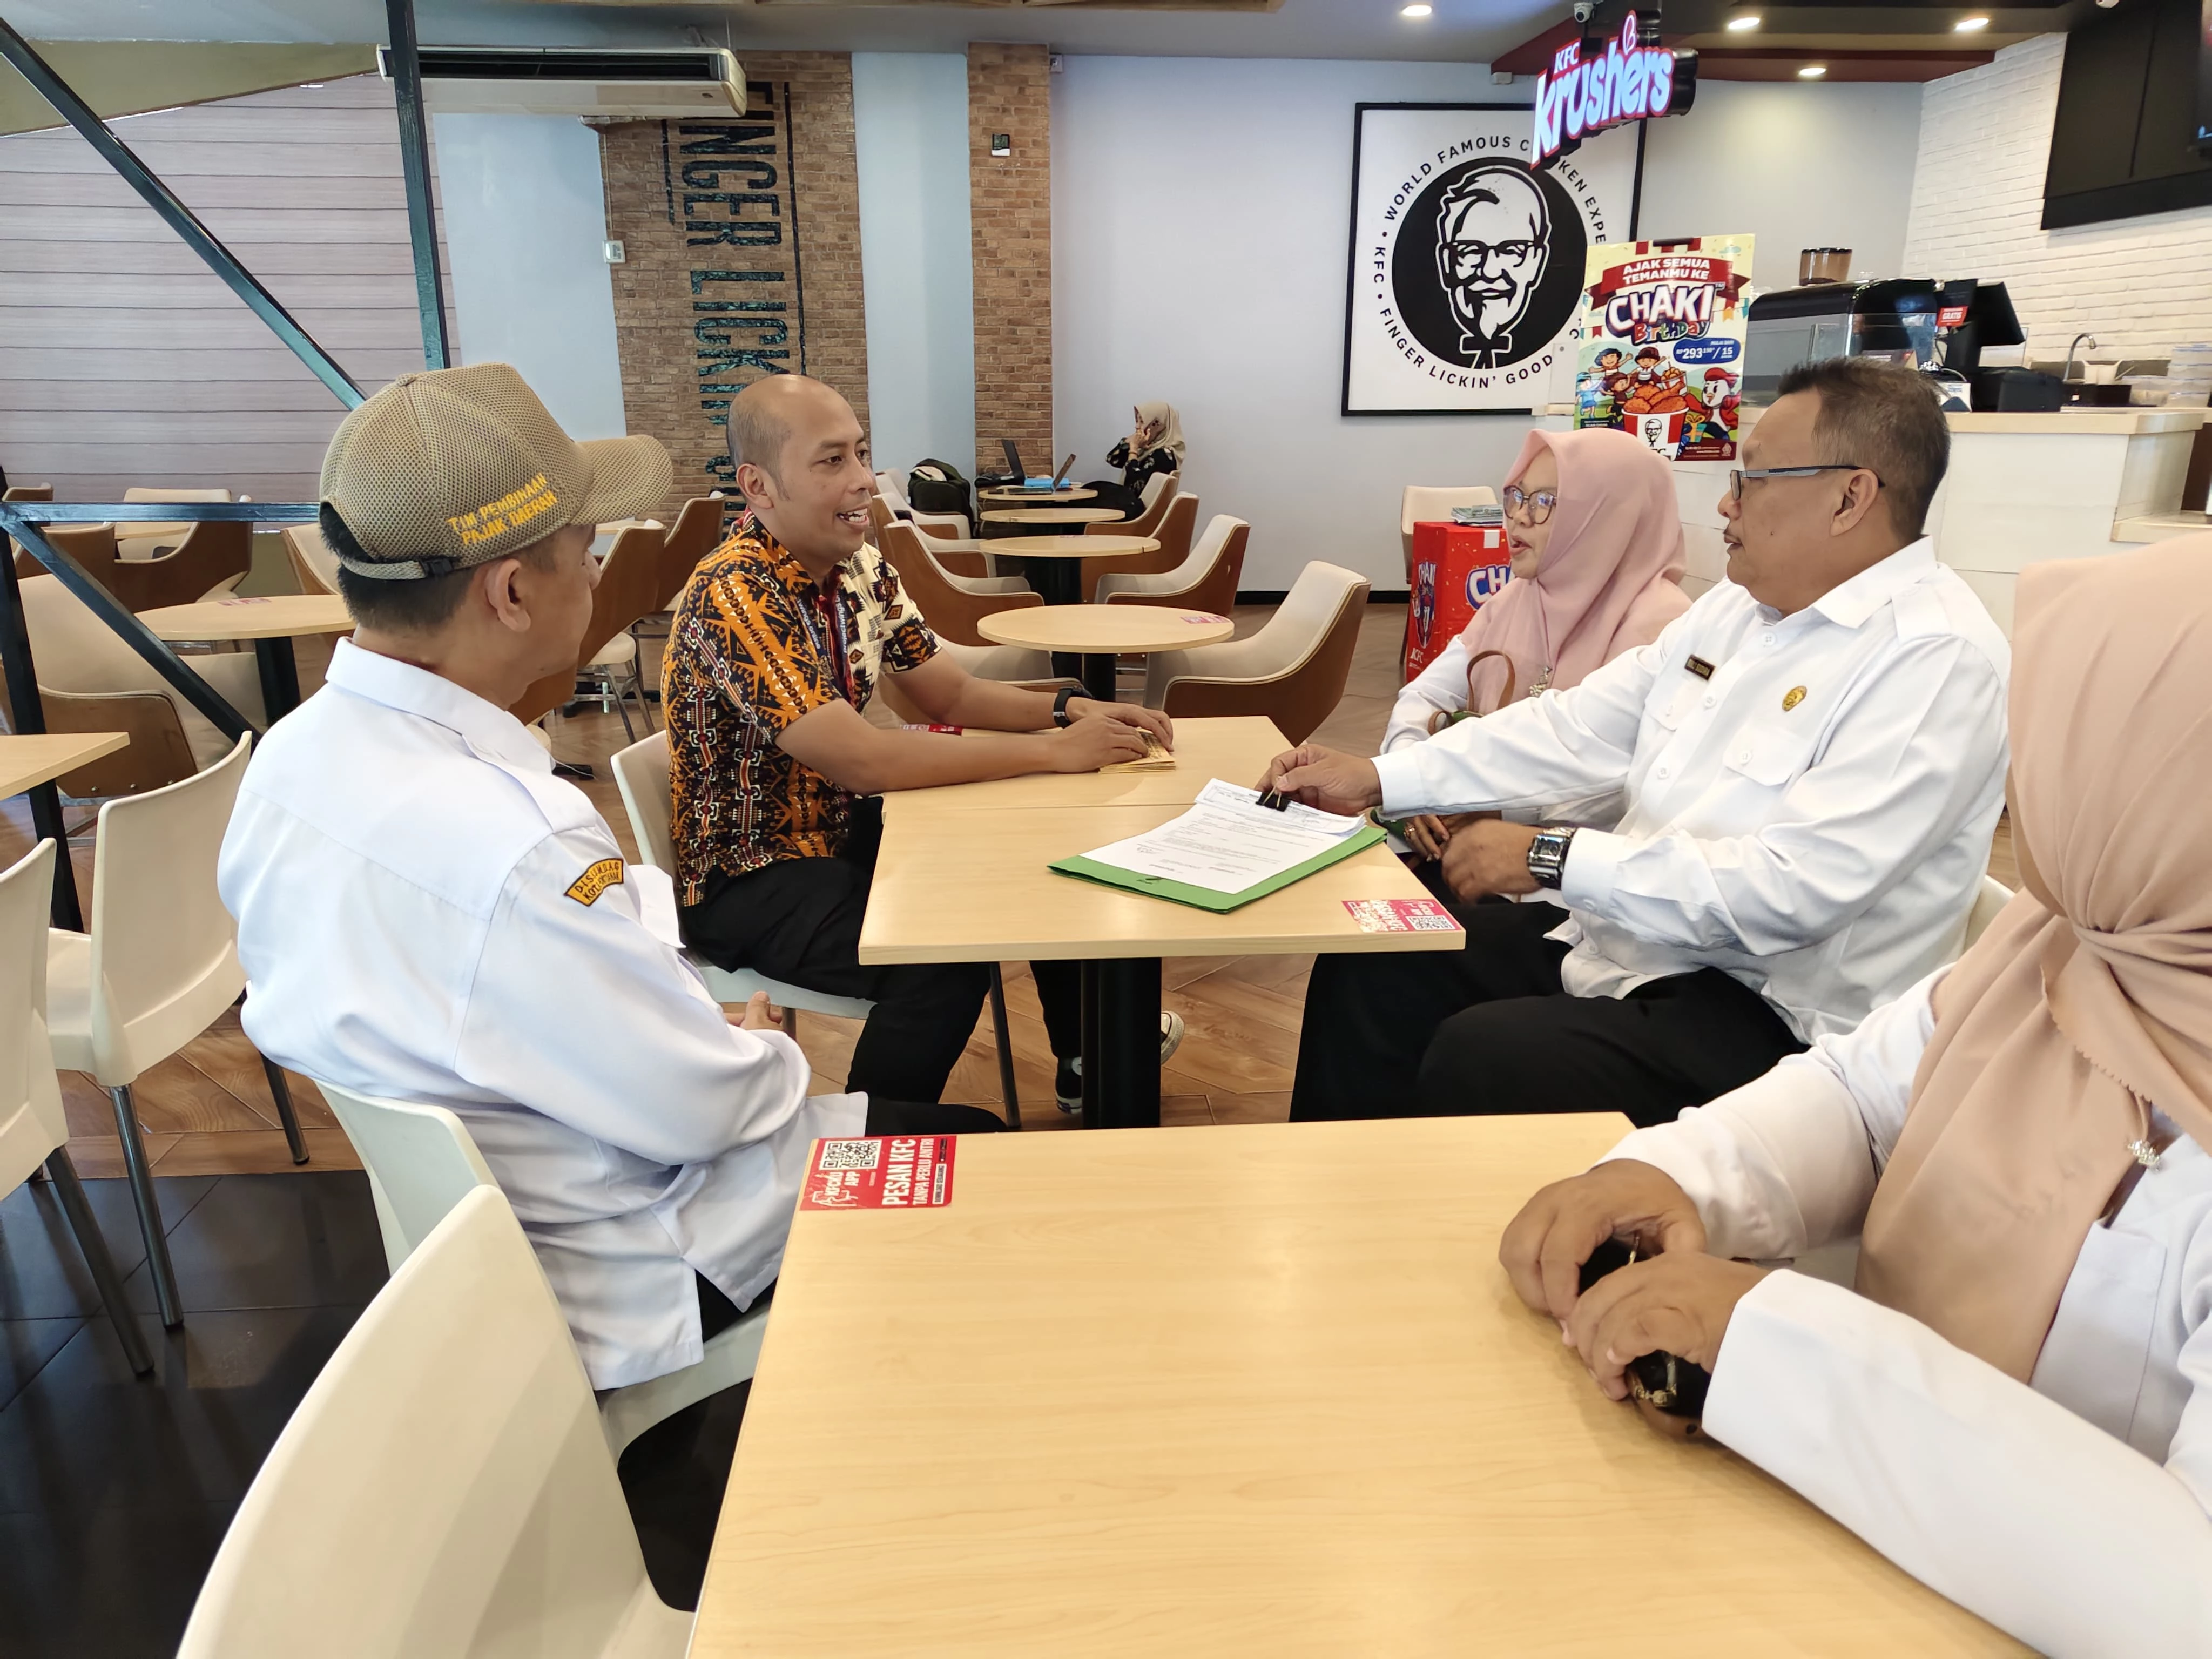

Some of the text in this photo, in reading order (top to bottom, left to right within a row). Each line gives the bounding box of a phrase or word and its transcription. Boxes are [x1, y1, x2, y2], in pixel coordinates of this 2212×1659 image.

[1554, 42, 1580, 73] KFC
[1384, 136, 1607, 244] WORLD FAMOUS CKEN EXPE
[1373, 246, 1386, 283] KFC
[1623, 259, 1710, 275] AJAK SEMUA
[1623, 270, 1710, 285] TEMANMU KE
[1608, 284, 1714, 331] CHAKI
[1380, 308, 1424, 368] FINGER
[1506, 354, 1553, 385] GOOD
[446, 473, 548, 531] TIM PEMBINAAN
[460, 490, 558, 545] PAJAK DAERAH
[844, 1171, 860, 1186] APP
[881, 1138, 916, 1205] PESAN KFC
[912, 1138, 934, 1205] TANPA PERLU ANTRI
